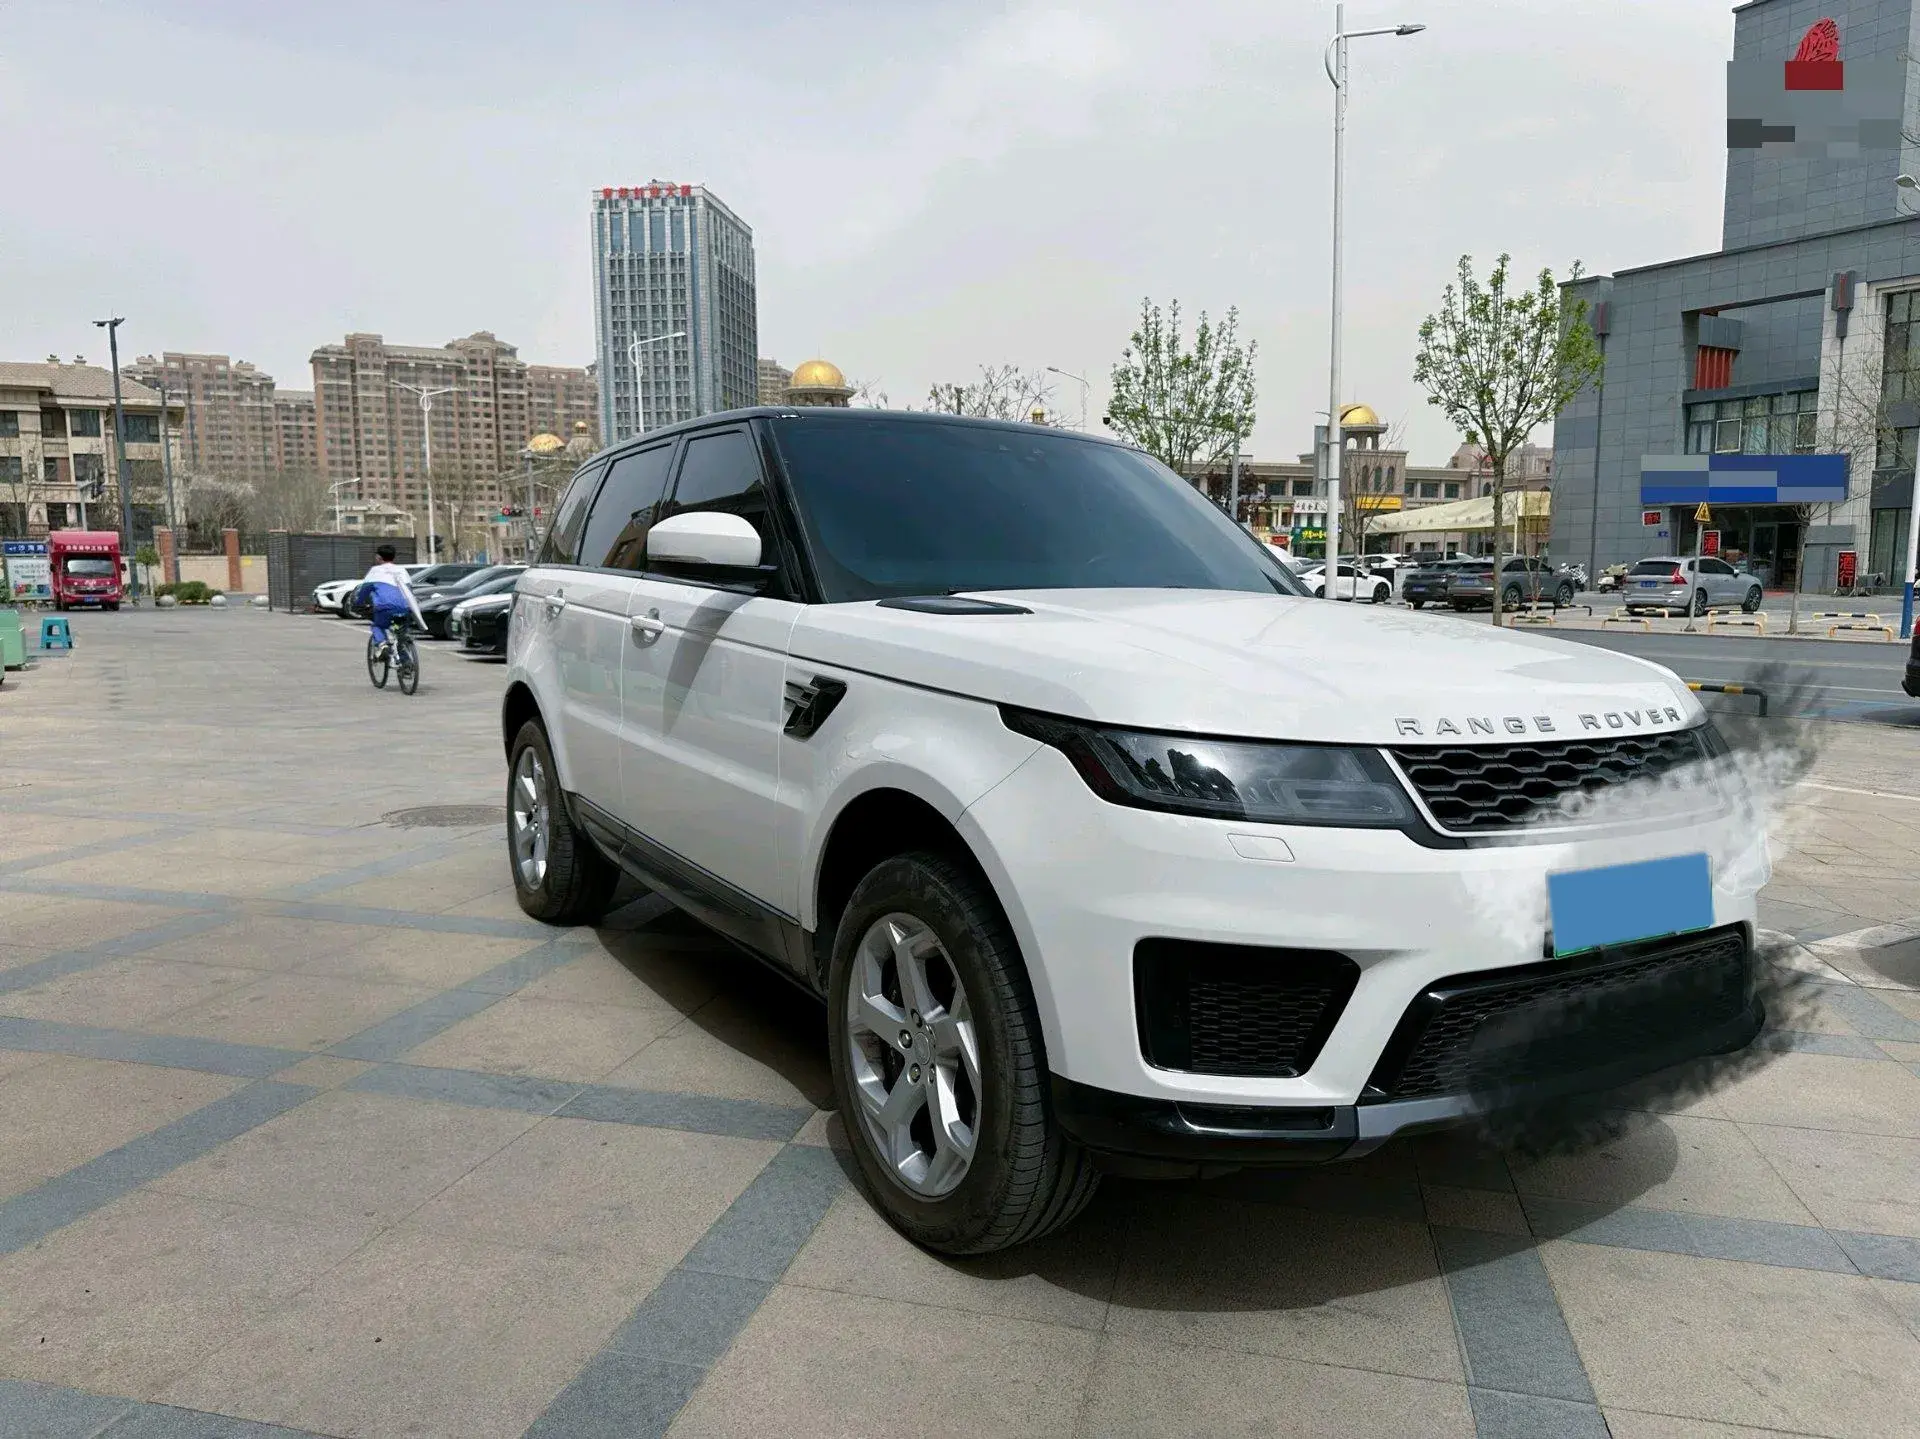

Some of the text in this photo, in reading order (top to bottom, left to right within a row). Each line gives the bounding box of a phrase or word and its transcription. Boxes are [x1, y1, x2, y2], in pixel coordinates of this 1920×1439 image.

[1839, 553, 1855, 586] 酒行
[1395, 706, 1681, 736] RANGE ROVER
